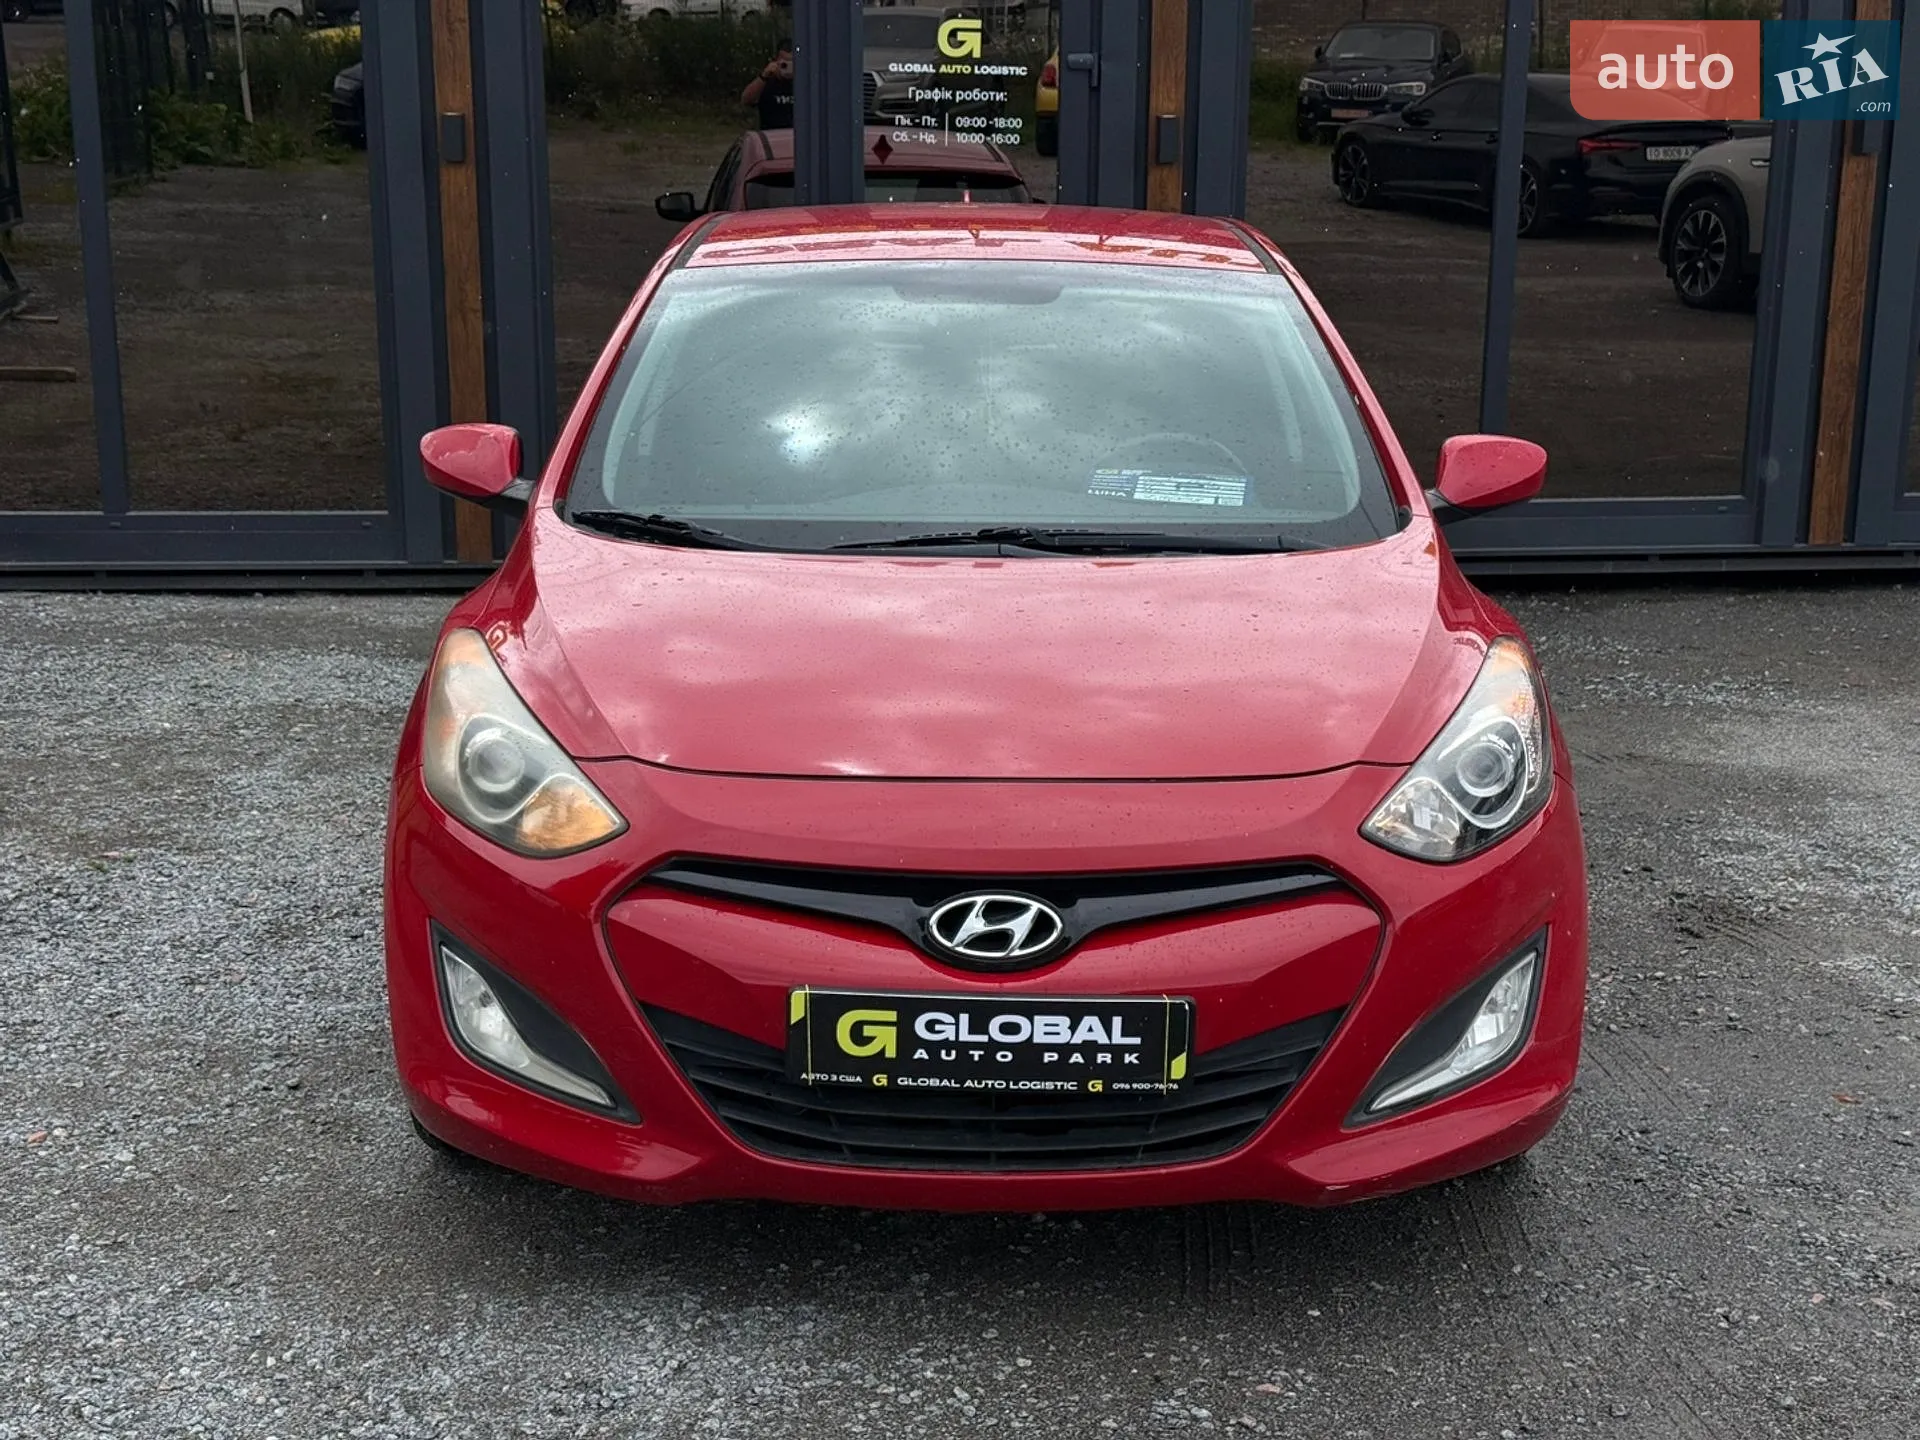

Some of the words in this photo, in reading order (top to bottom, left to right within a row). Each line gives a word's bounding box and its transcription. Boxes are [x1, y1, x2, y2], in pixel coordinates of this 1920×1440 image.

[888, 62, 936, 73] GLOBAL
[939, 64, 971, 75] AUTO
[974, 65, 1028, 76] LOGISTIC
[908, 86, 953, 102] Графік
[955, 88, 1008, 103] роботи:
[895, 115, 912, 126] Пн.
[922, 115, 939, 127] Пт.
[892, 131, 911, 142] Сб.
[914, 1011, 1141, 1045] GLOBAL
[913, 1049, 1014, 1062] AUTO
[1043, 1051, 1141, 1064] PARK
[897, 1076, 961, 1088] GLOBAL
[963, 1078, 1008, 1089] AUTO
[1009, 1079, 1078, 1091] LOGISTIC
[1111, 1082, 1131, 1091] 096
